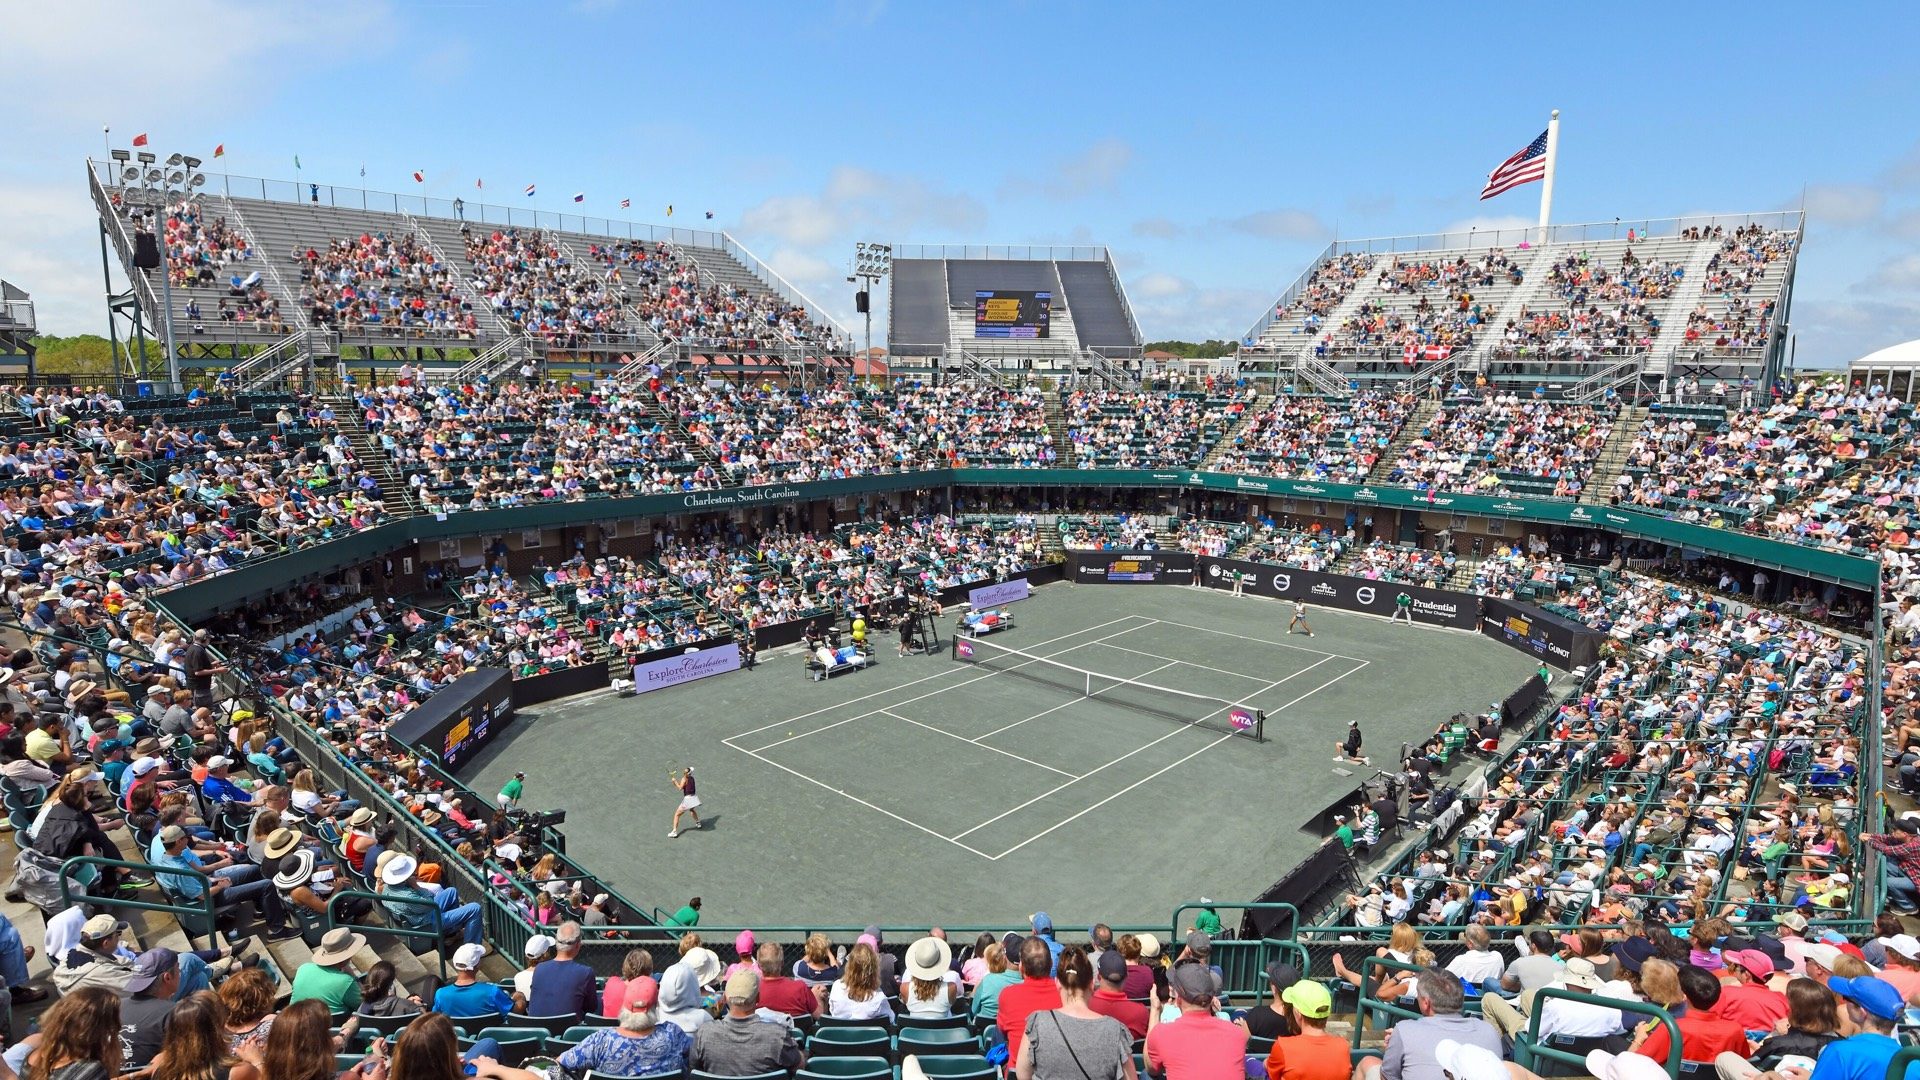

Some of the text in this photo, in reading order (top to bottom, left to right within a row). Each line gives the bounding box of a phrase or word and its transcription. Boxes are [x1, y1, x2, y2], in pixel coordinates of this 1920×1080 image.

[684, 486, 800, 507] Charleston, South Carolina
[1413, 598, 1457, 613] Prudential
[958, 644, 973, 655] WTA
[648, 656, 728, 682] Explore Charleston
[686, 668, 714, 679] CAROLINA
[1230, 713, 1252, 726] WTA
